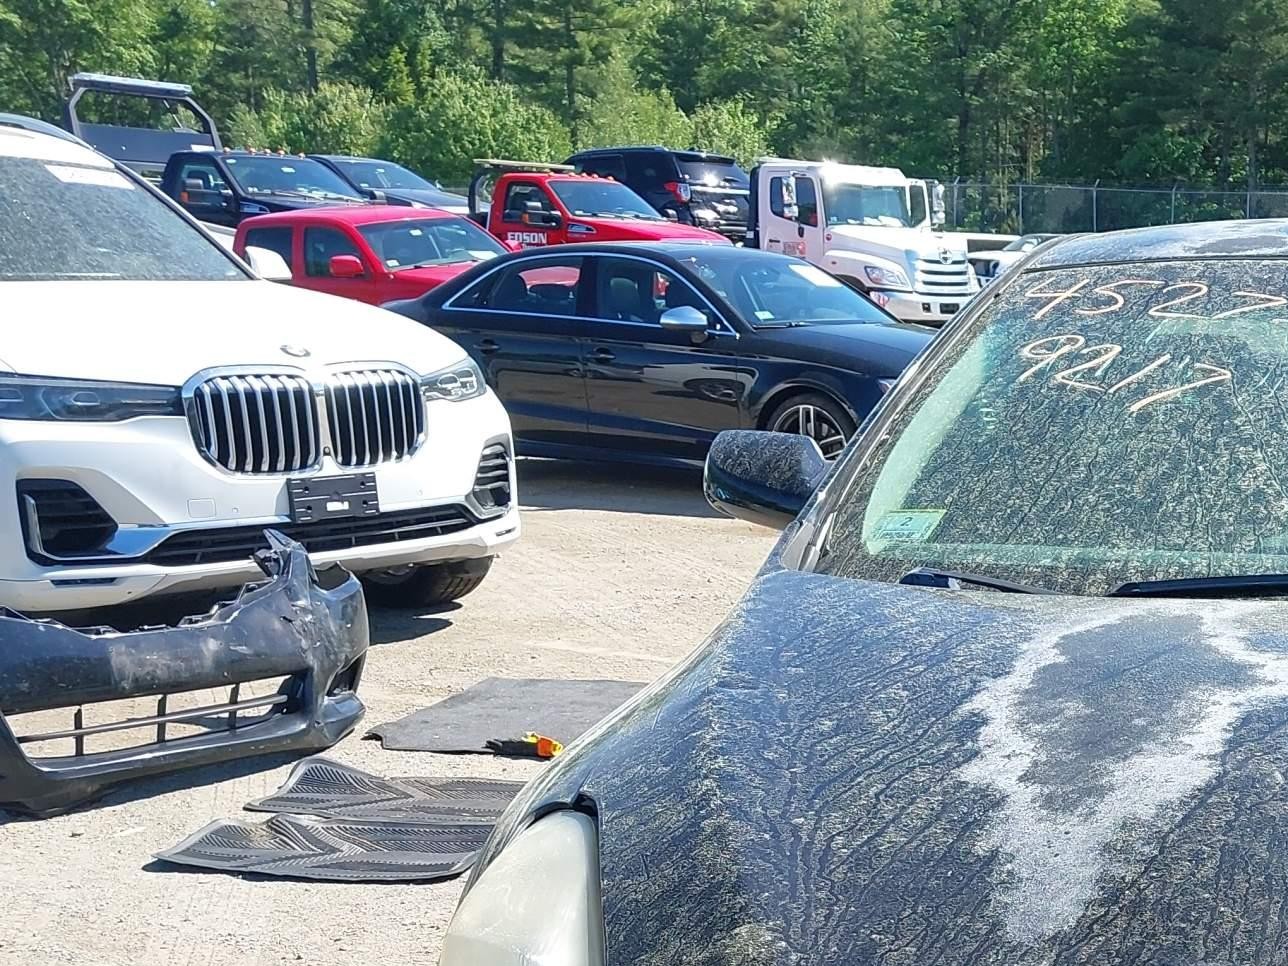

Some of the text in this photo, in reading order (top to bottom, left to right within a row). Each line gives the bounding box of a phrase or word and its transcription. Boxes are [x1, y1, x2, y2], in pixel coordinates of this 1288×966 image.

[507, 232, 547, 244] EDSON
[1024, 277, 1288, 321] 4527
[1017, 334, 1232, 416] 9217
